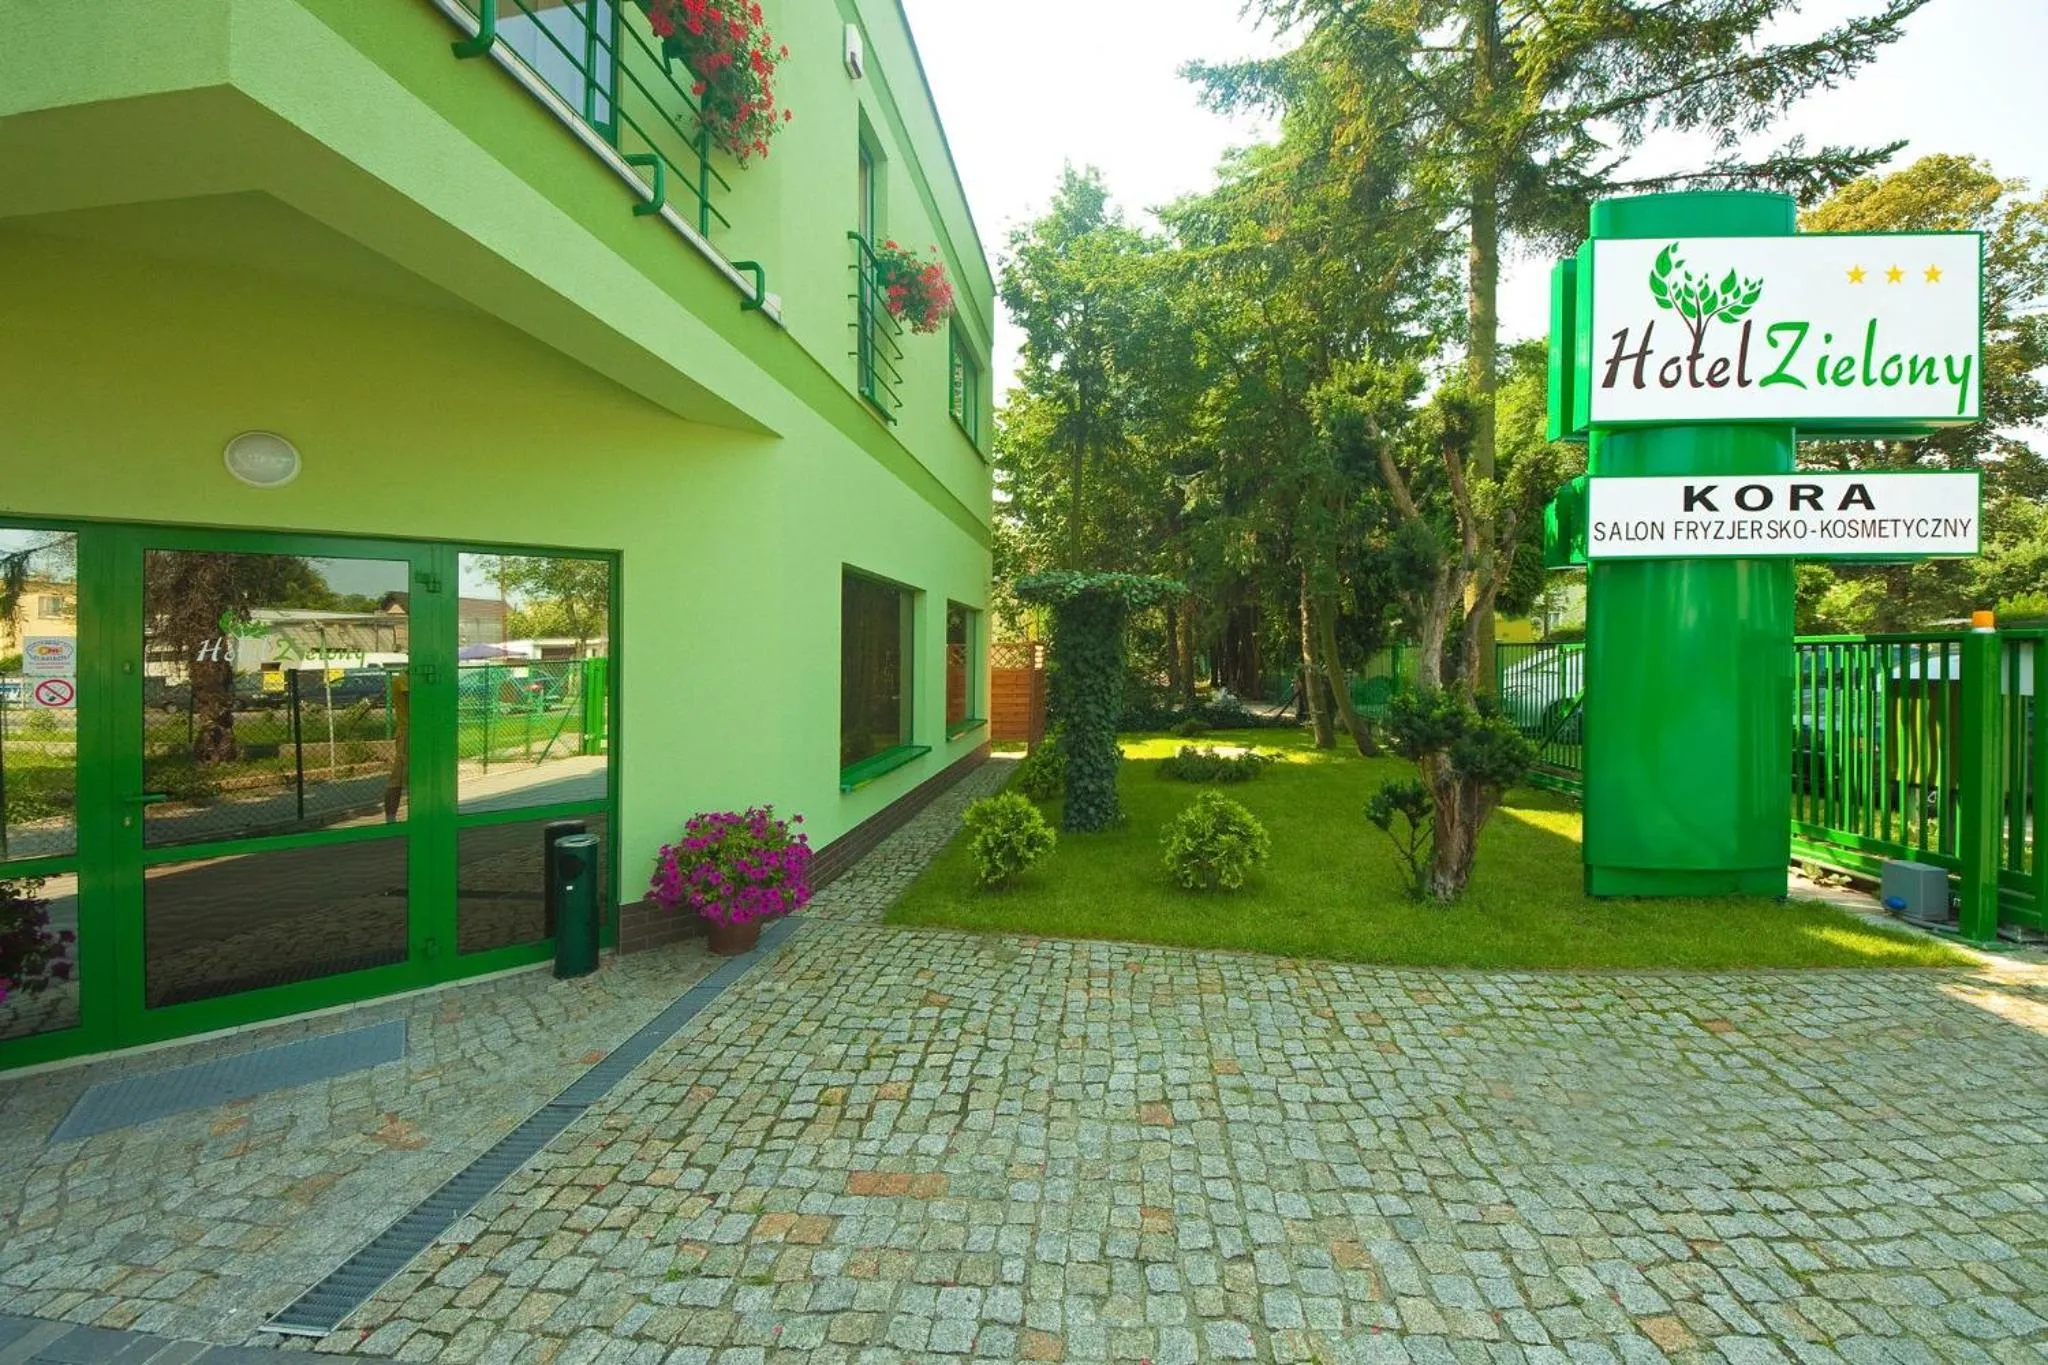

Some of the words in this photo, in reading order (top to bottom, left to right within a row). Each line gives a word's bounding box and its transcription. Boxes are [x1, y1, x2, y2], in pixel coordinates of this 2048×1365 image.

[1602, 319, 1752, 389] Hotel
[1759, 318, 1973, 415] Zielony
[1683, 484, 1876, 512] KORA
[1593, 521, 1665, 542] SALON
[1674, 518, 1972, 541] FRYZJERSKO-KOSMETYCZNY
[196, 637, 267, 662] Hol
[273, 636, 365, 669] Zelony
